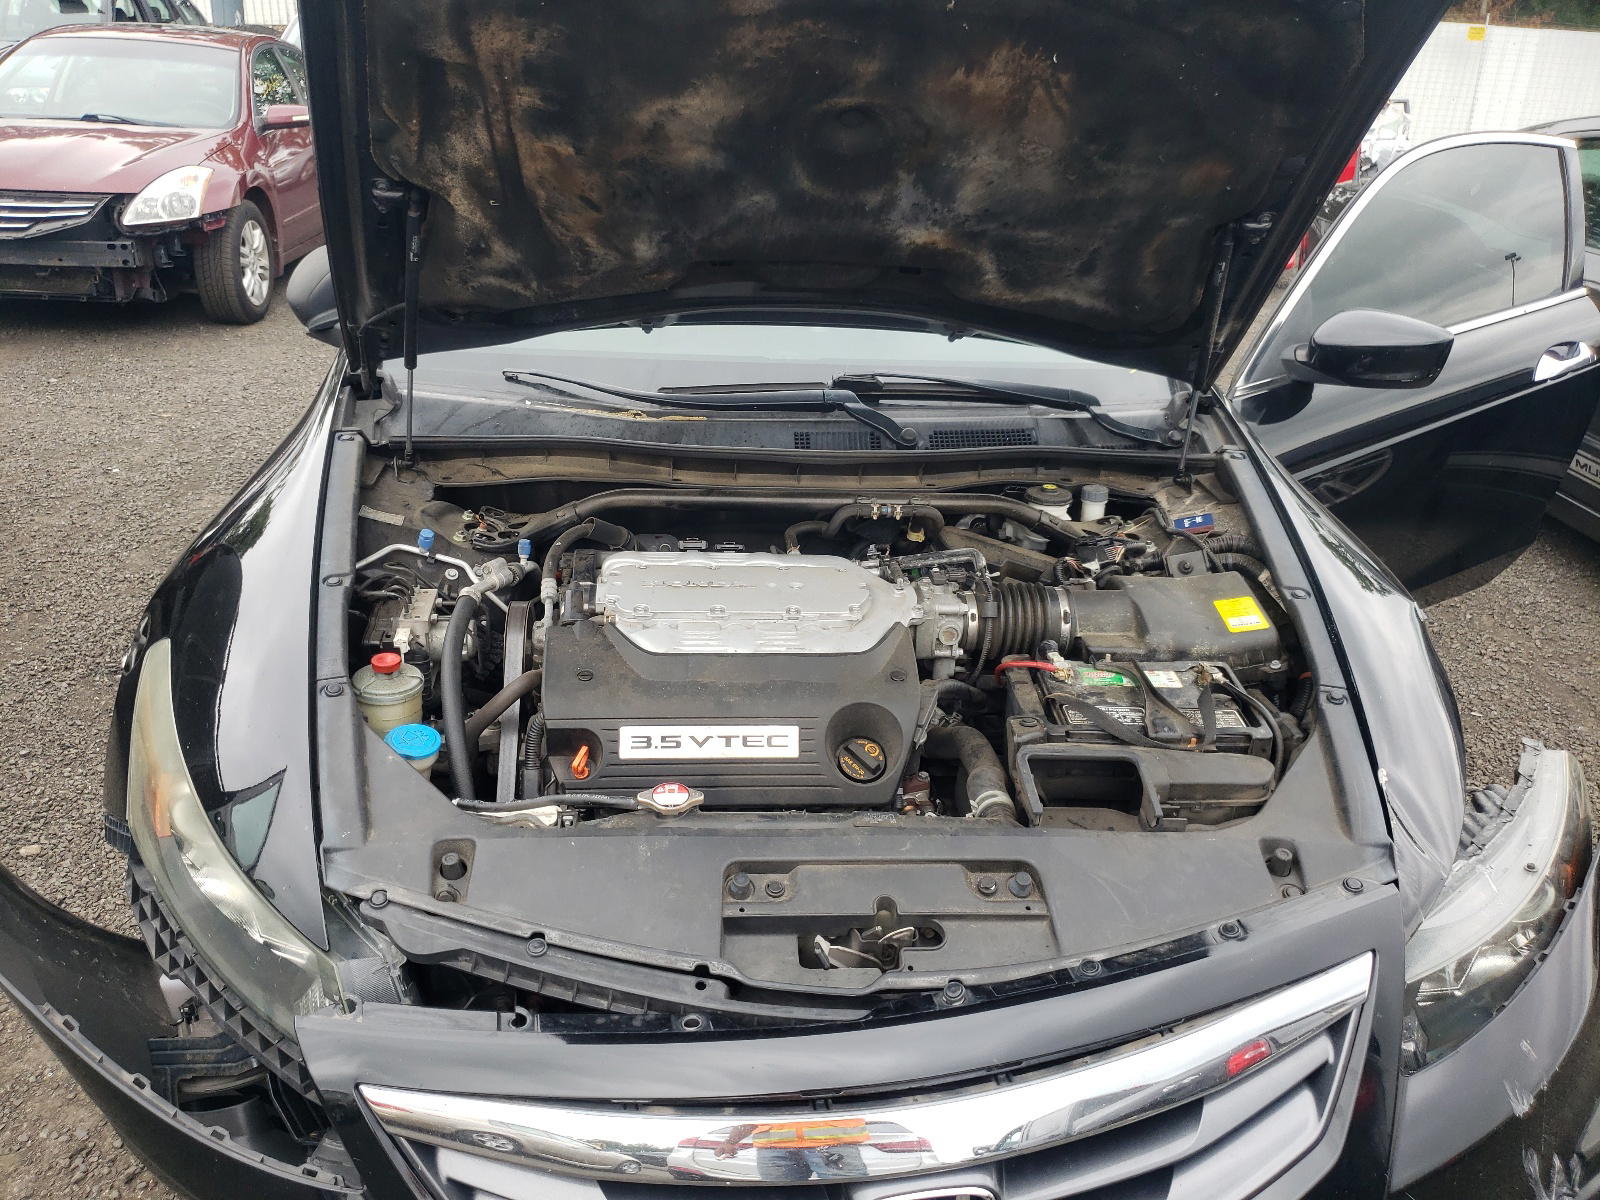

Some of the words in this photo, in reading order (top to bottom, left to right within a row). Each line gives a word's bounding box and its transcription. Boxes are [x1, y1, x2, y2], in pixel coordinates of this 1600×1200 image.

[1575, 458, 1600, 479] MU
[631, 735, 682, 750] 3.5
[688, 735, 789, 749] VTEC
